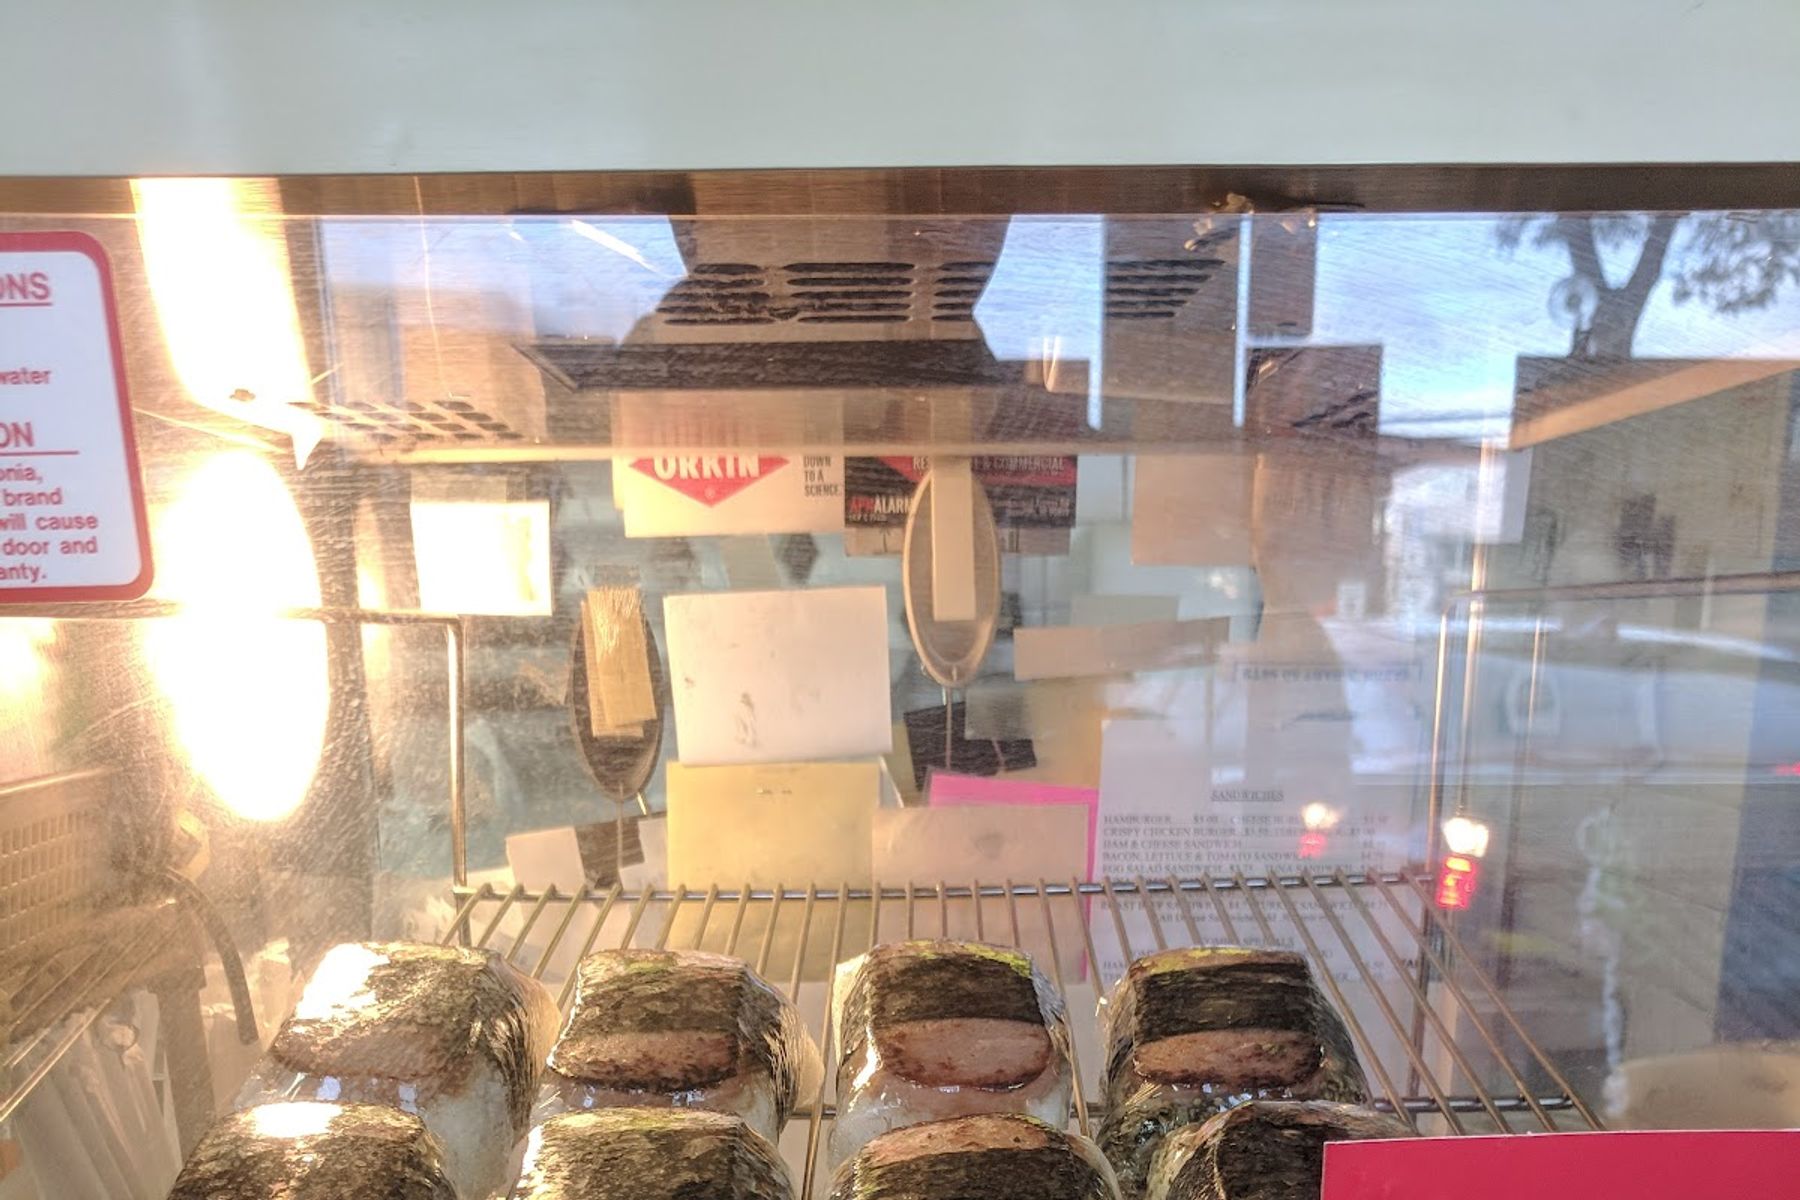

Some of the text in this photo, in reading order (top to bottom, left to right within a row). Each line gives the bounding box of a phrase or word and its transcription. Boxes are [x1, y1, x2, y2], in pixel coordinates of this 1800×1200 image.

[0, 271, 50, 301] NS
[653, 455, 760, 480] ORKIN
[803, 456, 831, 467] DOWN
[804, 470, 825, 482] TO A
[3, 488, 62, 506] brand
[36, 515, 99, 530] cause
[3, 537, 98, 556] door and
[1211, 790, 1284, 800] SANDWICHES
